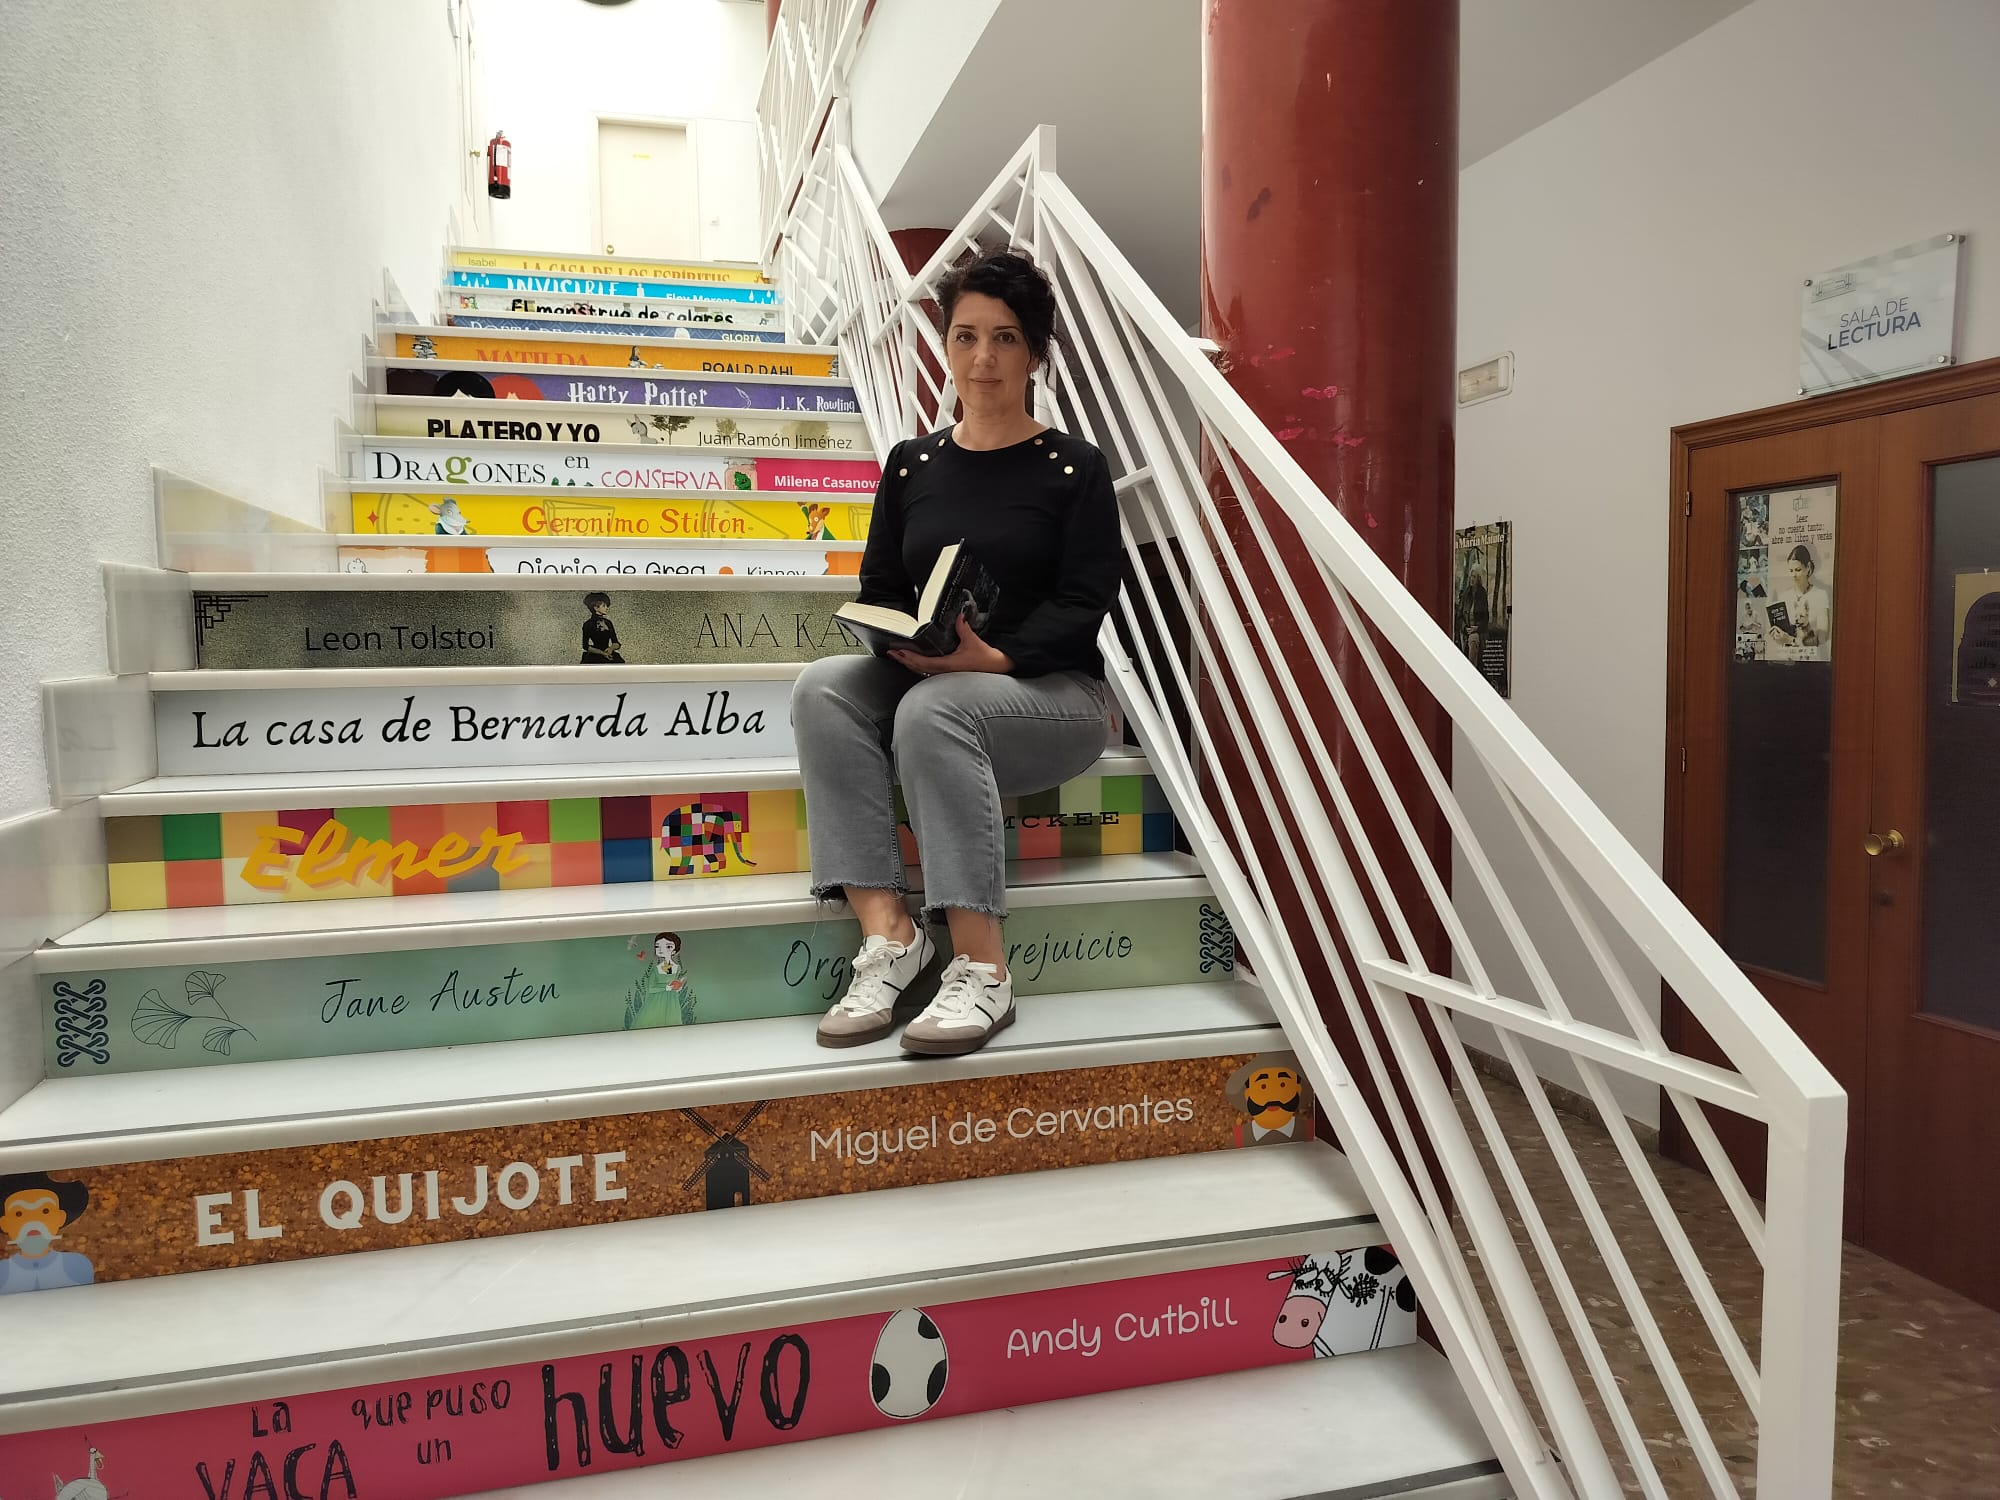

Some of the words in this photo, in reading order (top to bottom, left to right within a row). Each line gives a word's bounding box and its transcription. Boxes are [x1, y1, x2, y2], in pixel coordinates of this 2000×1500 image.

[468, 257, 497, 267] Isabel
[511, 299, 528, 312] El
[638, 305, 659, 319] de
[1840, 305, 1881, 328] SALA
[1886, 297, 1909, 317] DE
[1827, 312, 1922, 350] LECTURA
[567, 382, 629, 404] Harry
[644, 381, 708, 407] Potter
[776, 396, 790, 411] J.
[796, 396, 811, 411] K.
[816, 395, 855, 413] Rowling
[427, 419, 542, 441] PLATERO
[547, 423, 563, 442] Y
[567, 423, 601, 443] YO
[698, 431, 732, 446] Juan
[737, 432, 790, 447] Ramón
[795, 434, 853, 449] Jiménez
[564, 455, 590, 469] en
[601, 469, 722, 490] CONSERVA
[774, 475, 819, 488] Milena
[521, 505, 650, 534] Geronimo
[659, 508, 746, 534] Stilton
[304, 626, 382, 651] Leon
[391, 624, 495, 651] Tolstoi
[694, 613, 781, 648] ANA
[792, 613, 864, 650] KA
[192, 710, 248, 749] La
[266, 713, 363, 747] casa
[381, 694, 432, 744] de
[449, 692, 649, 742] Bernarda
[662, 690, 767, 736] Alba
[239, 817, 532, 890] Elmer
[1008, 931, 1132, 981] rejuicio
[320, 976, 410, 1024] Jane
[429, 966, 561, 1013] Austen
[810, 1114, 937, 1166] Miguel
[948, 1108, 997, 1146] de
[1006, 1093, 1195, 1139] Cervantes
[194, 1187, 284, 1247] EL
[318, 1150, 628, 1231] QUIJOTE
[1006, 1318, 1103, 1358] Andy
[1115, 1296, 1239, 1343] Cutbill
[351, 1389, 414, 1432] que
[426, 1378, 513, 1424] puso
[541, 1334, 812, 1473] huevo
[195, 1439, 358, 1500] VACA
[416, 1436, 453, 1467] un
